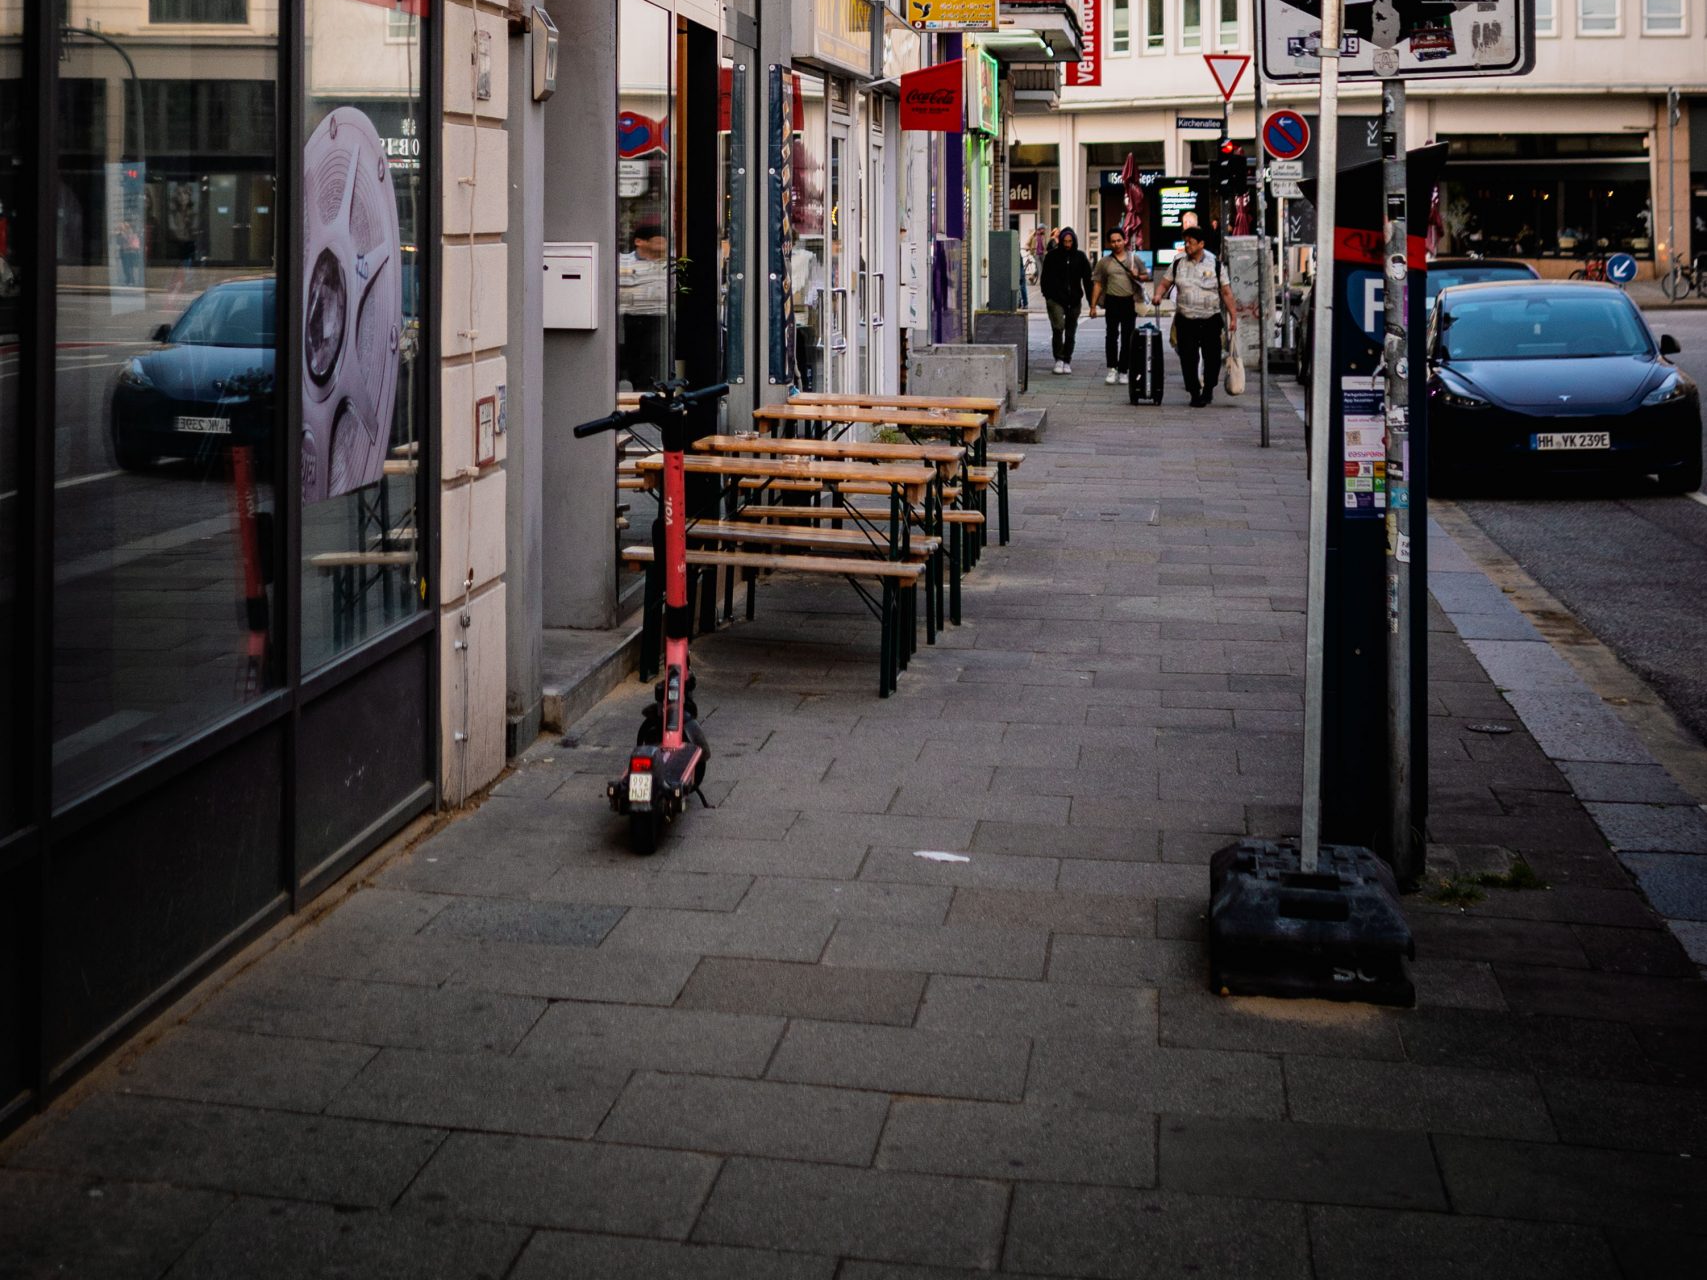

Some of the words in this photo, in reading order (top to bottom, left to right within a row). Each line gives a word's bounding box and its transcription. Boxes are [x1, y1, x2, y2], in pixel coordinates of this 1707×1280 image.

[1178, 120, 1221, 128] Kirchenallee
[1010, 184, 1032, 200] afel
[1538, 435, 1553, 448] HH
[1561, 434, 1577, 447] YK
[1579, 433, 1609, 447] 239E
